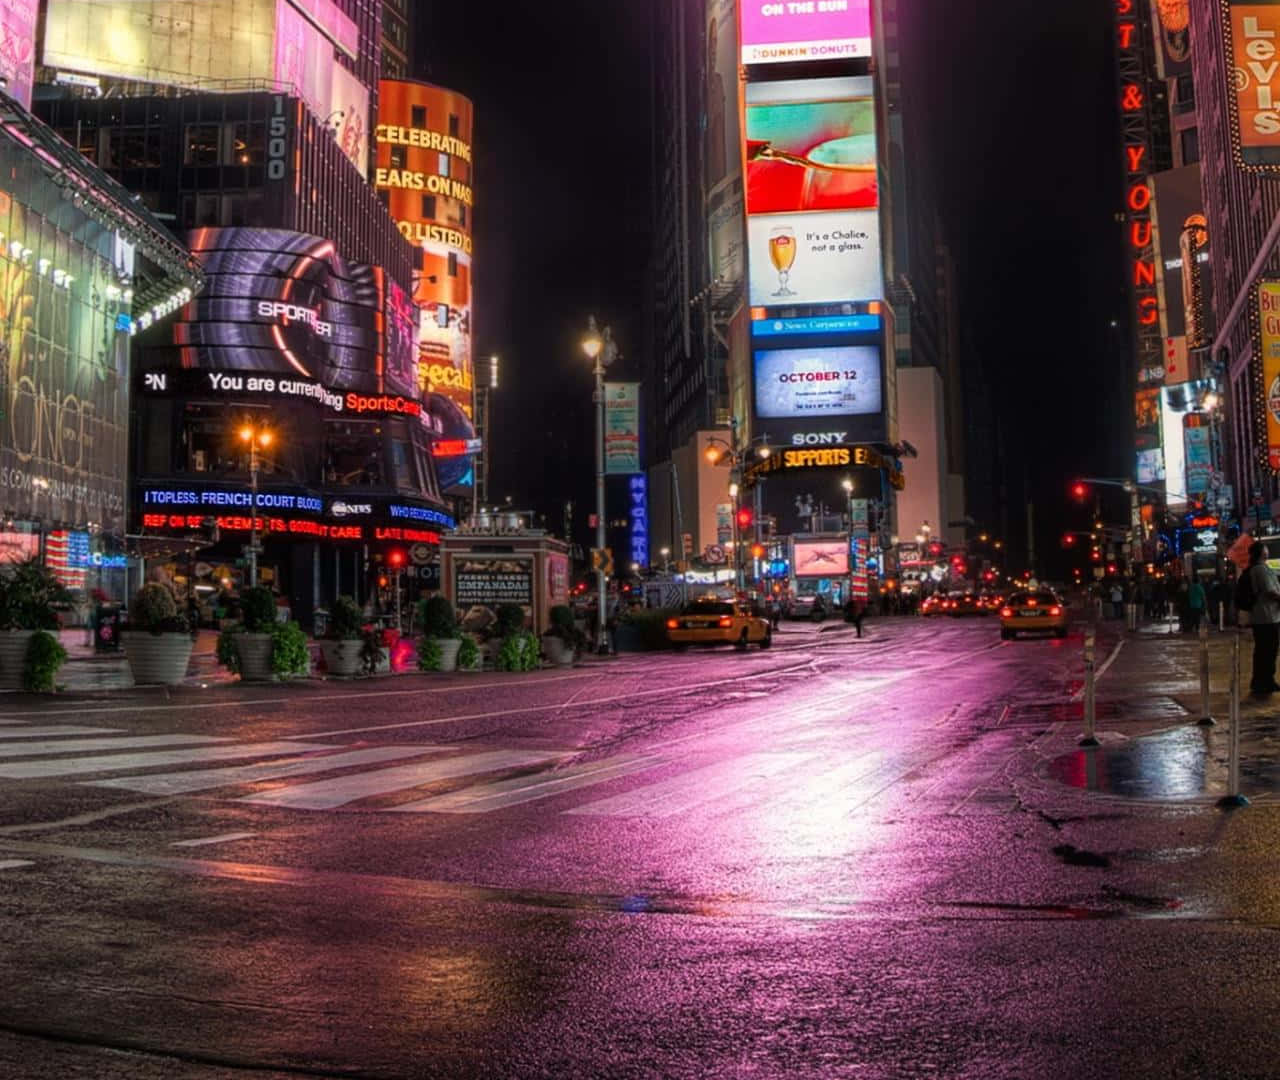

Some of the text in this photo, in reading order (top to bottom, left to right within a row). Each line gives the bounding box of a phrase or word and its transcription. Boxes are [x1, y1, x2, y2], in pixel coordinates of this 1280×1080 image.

[761, 0, 848, 17] ON THE RUN
[810, 43, 858, 56] DONUTS
[1122, 84, 1145, 110] &
[266, 95, 288, 181] 1500
[375, 124, 472, 162] CELEBRATING
[376, 167, 451, 196] EARS ON
[415, 222, 462, 248] LISTED
[806, 230, 822, 241] It's
[832, 229, 870, 241] Chalice,
[1127, 146, 1158, 325] YOUNG
[811, 242, 826, 252] not
[837, 240, 865, 253] glass.
[209, 372, 243, 391] You
[247, 375, 276, 392] are
[779, 370, 857, 383] OCTOBER 12
[792, 432, 848, 445] SONY
[784, 448, 850, 467] SUPPORTS
[150, 491, 200, 504] TOPLESS:
[201, 492, 253, 506] FRENCH
[256, 494, 295, 508] COURT
[330, 526, 362, 538] CARE
